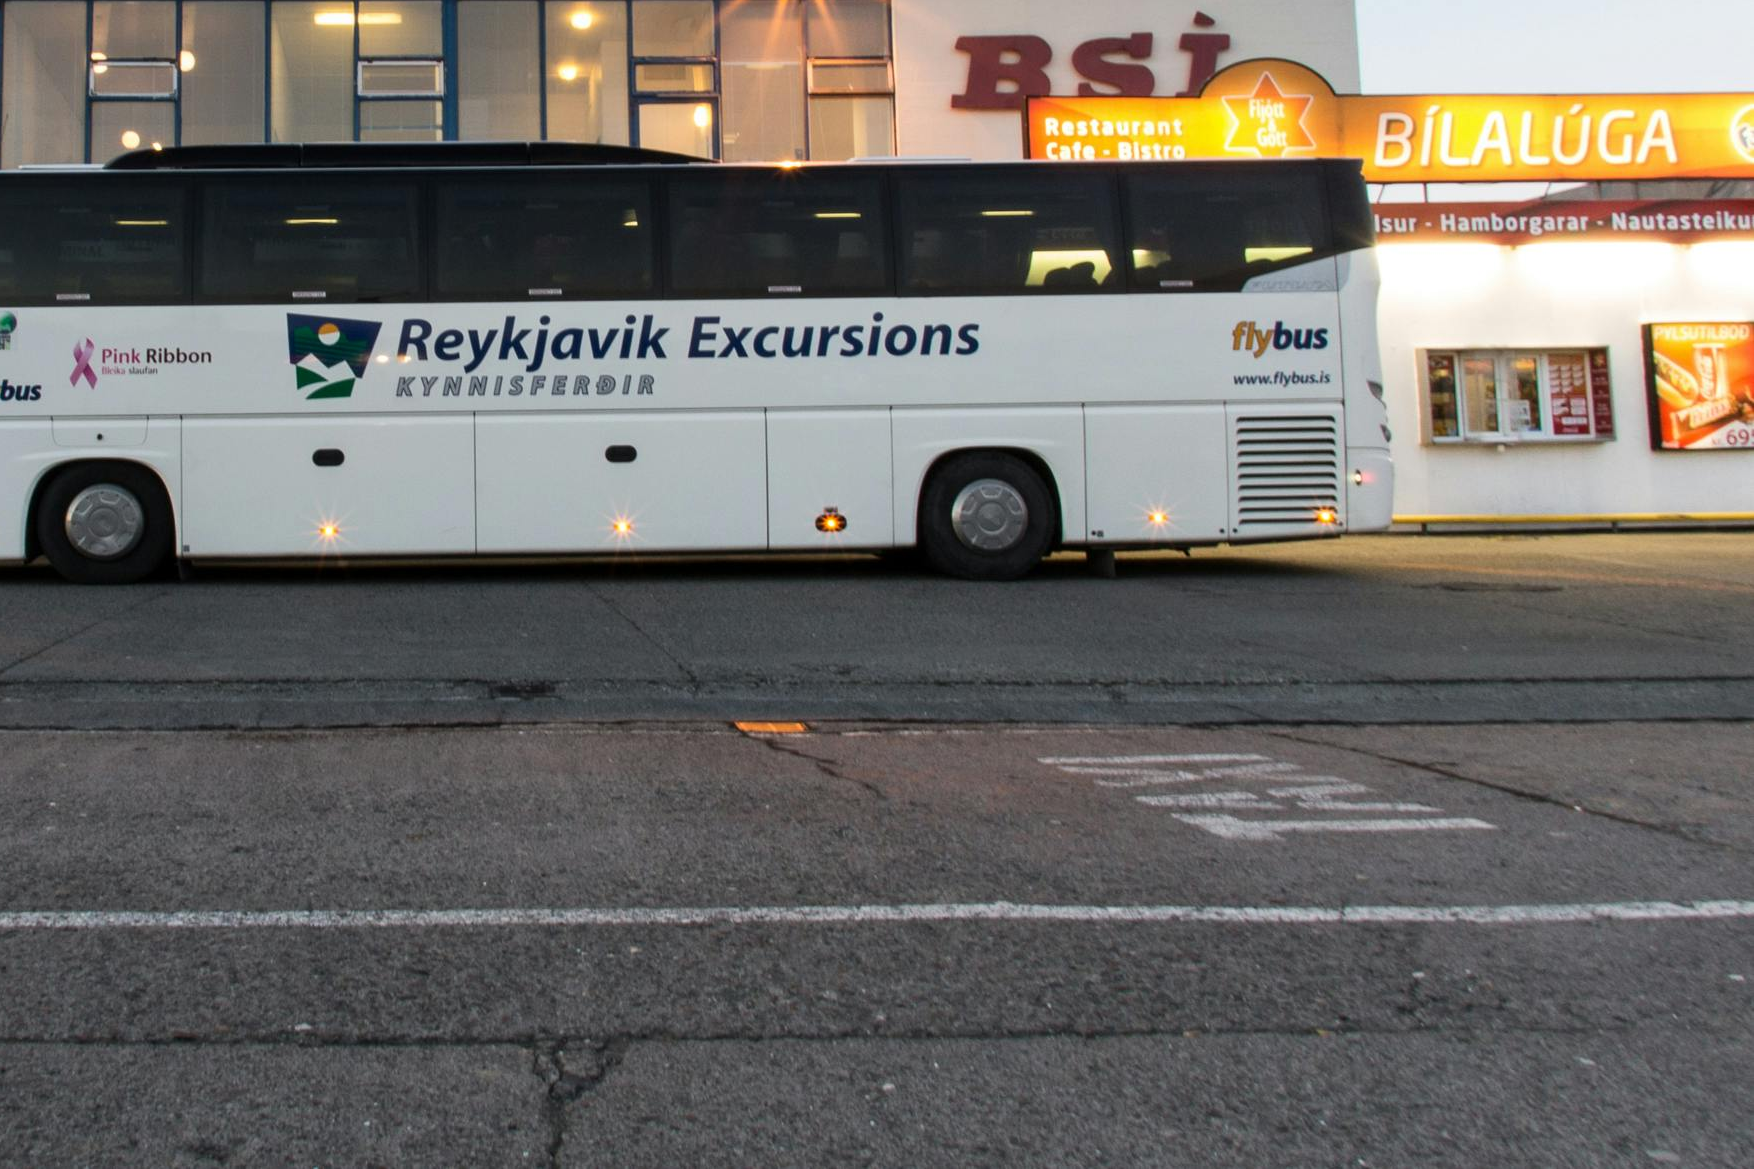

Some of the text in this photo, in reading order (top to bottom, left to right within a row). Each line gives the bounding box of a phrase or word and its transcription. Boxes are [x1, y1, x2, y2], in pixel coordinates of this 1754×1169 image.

[1045, 117, 1183, 136] Restaurant
[1373, 104, 1678, 167] BÍLALÚGA
[1046, 142, 1095, 160] Cafe
[1117, 141, 1186, 160] Bistro
[1440, 213, 1589, 235] Hamborgarar
[396, 311, 980, 374] Reykjavik Excursions
[1232, 320, 1329, 359] flybus
[101, 348, 212, 364] Pink Ribbon
[396, 373, 655, 398] KYNNISFERÐIR
[1233, 370, 1331, 387] www.flybus.is
